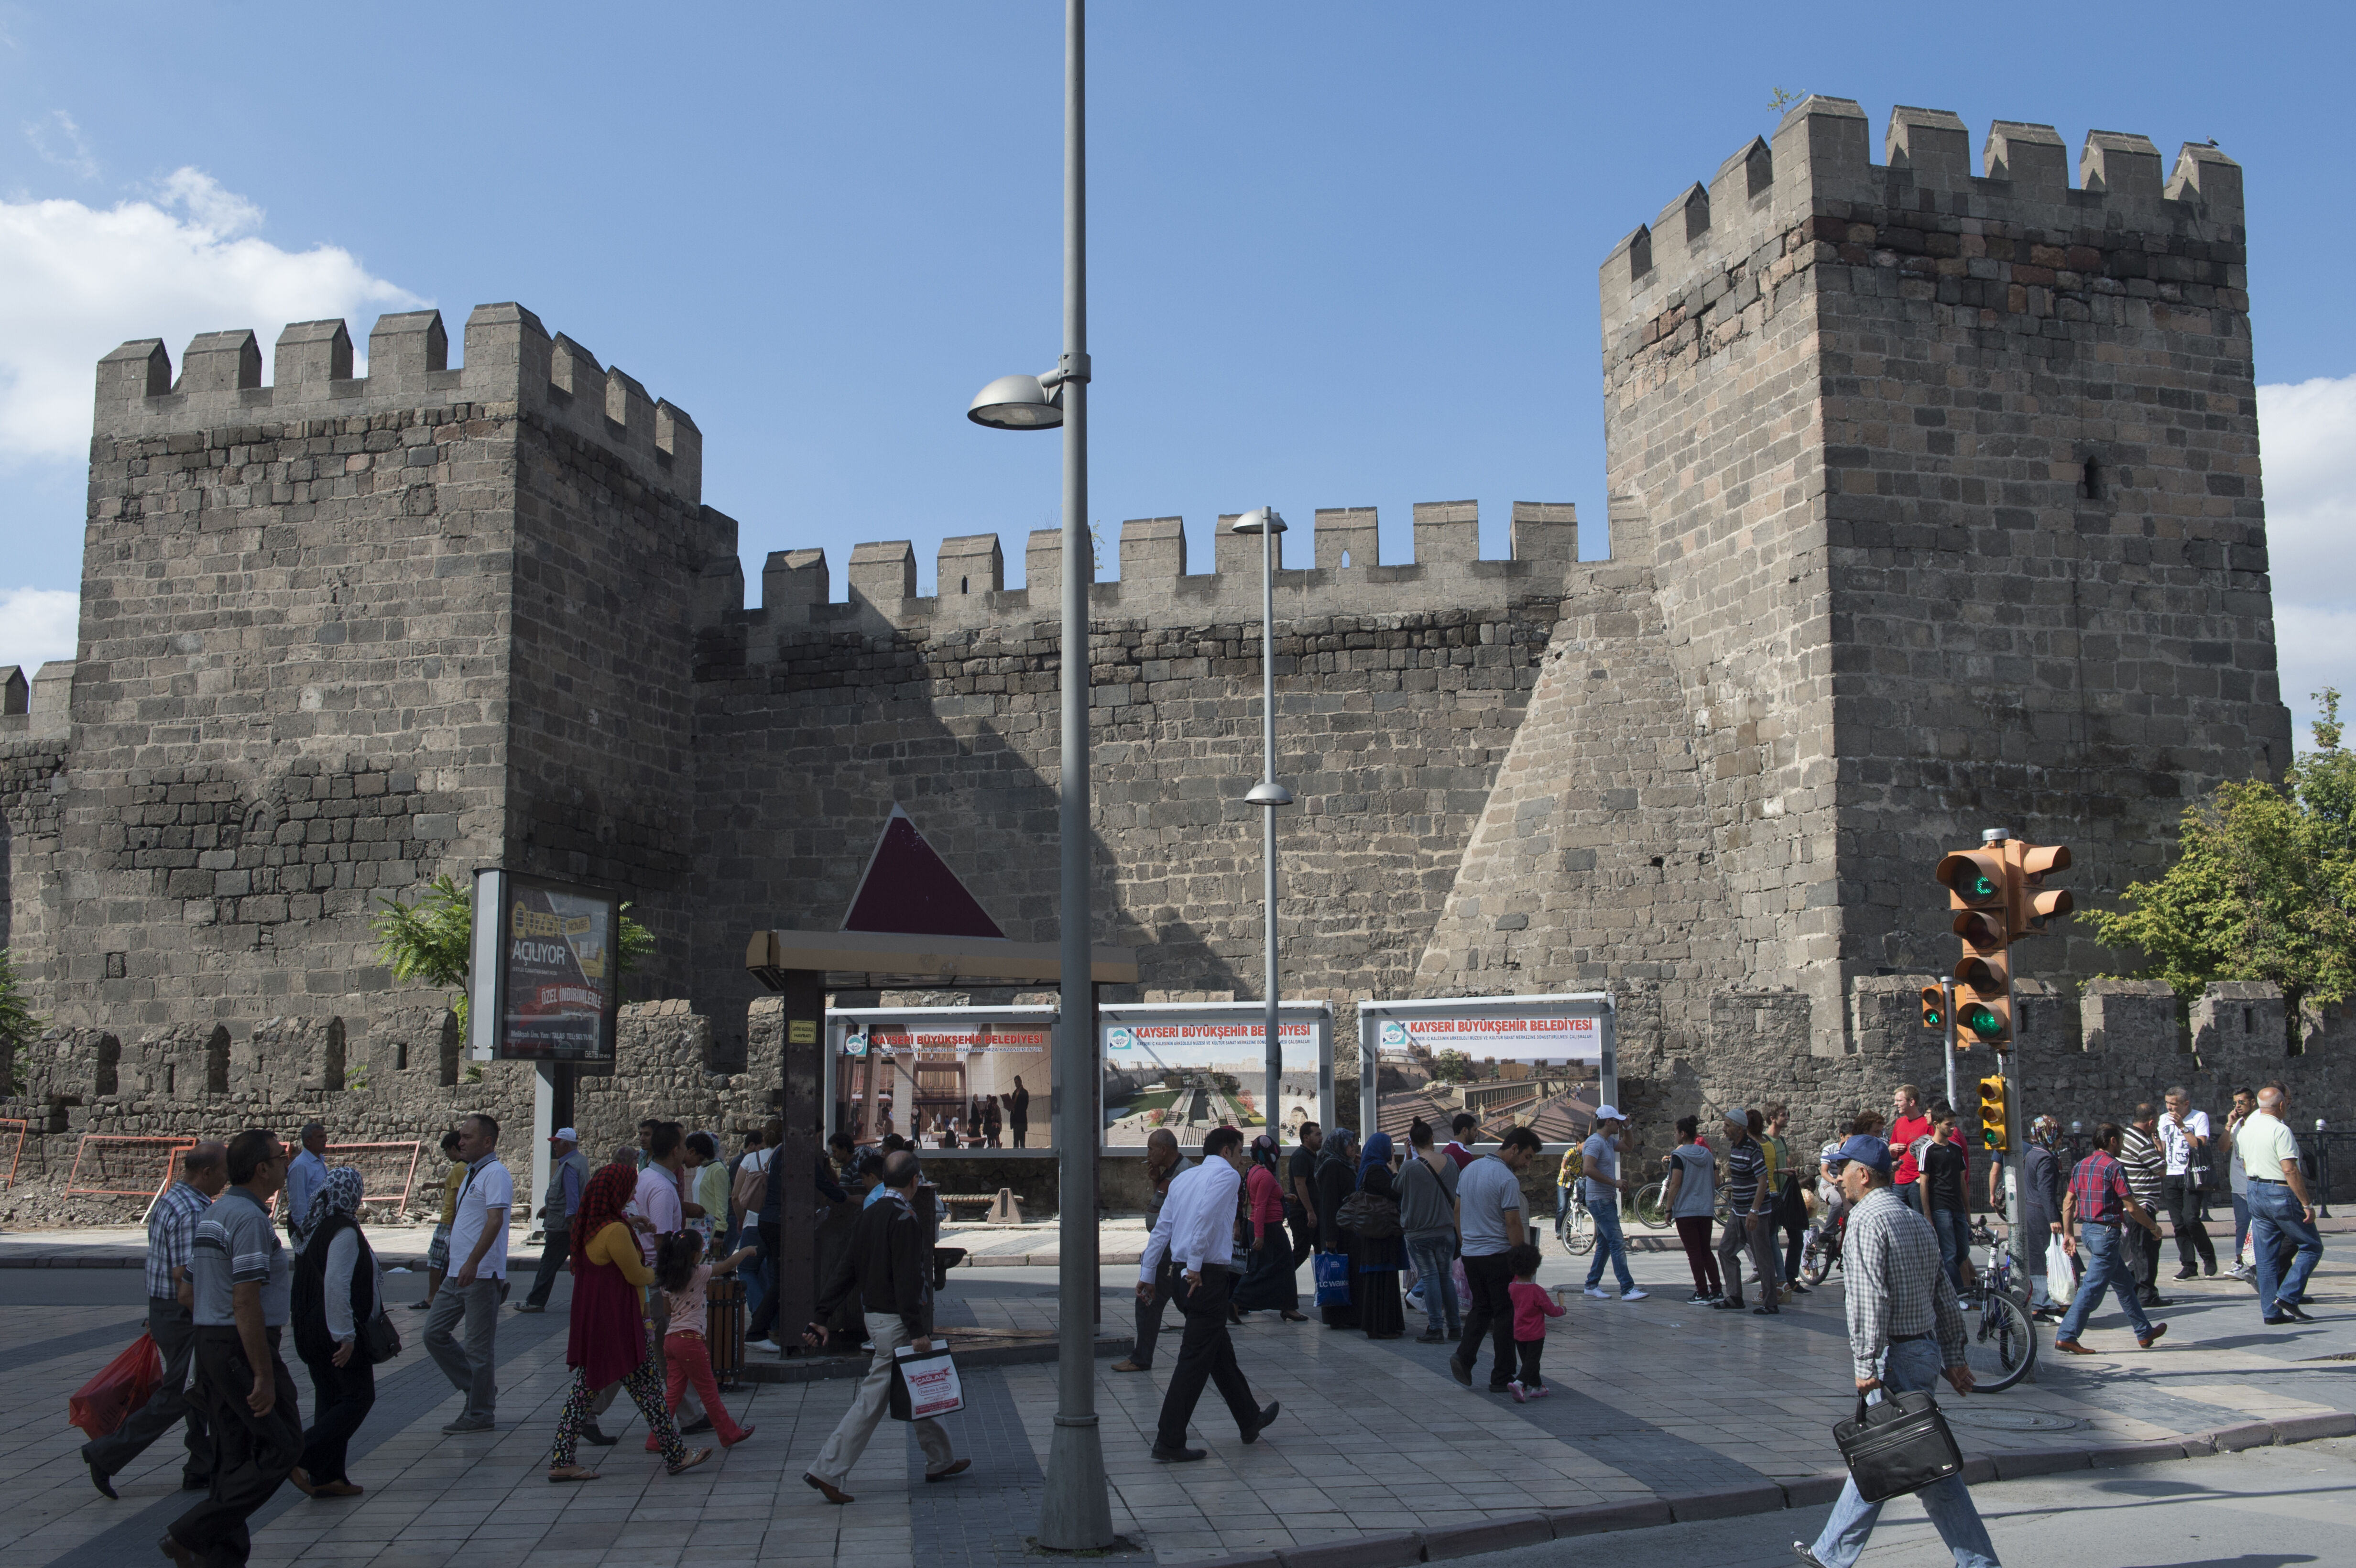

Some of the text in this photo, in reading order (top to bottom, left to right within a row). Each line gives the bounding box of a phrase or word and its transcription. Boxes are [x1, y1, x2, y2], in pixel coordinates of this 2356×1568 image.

[568, 919, 588, 932] HOUSE
[512, 940, 565, 966] AÇILIYOR
[541, 985, 602, 1010] ÖZEL İNDİRİMLERLE
[1136, 1024, 1178, 1038] KAYSERİ
[1181, 1023, 1248, 1040] BÜYÜKŞEHİR
[1251, 1022, 1310, 1036] BEDİYESİ
[1410, 1018, 1454, 1033] KAYSERİ
[1458, 1018, 1527, 1034] BÜYÜKŞEHİR
[1530, 1016, 1592, 1031] BELEDİYESİ
[871, 1033, 914, 1045] KAYSERİ
[917, 1033, 982, 1046] BÜYÜKŞEHİR
[984, 1033, 1043, 1044] BELEDİYESİ
